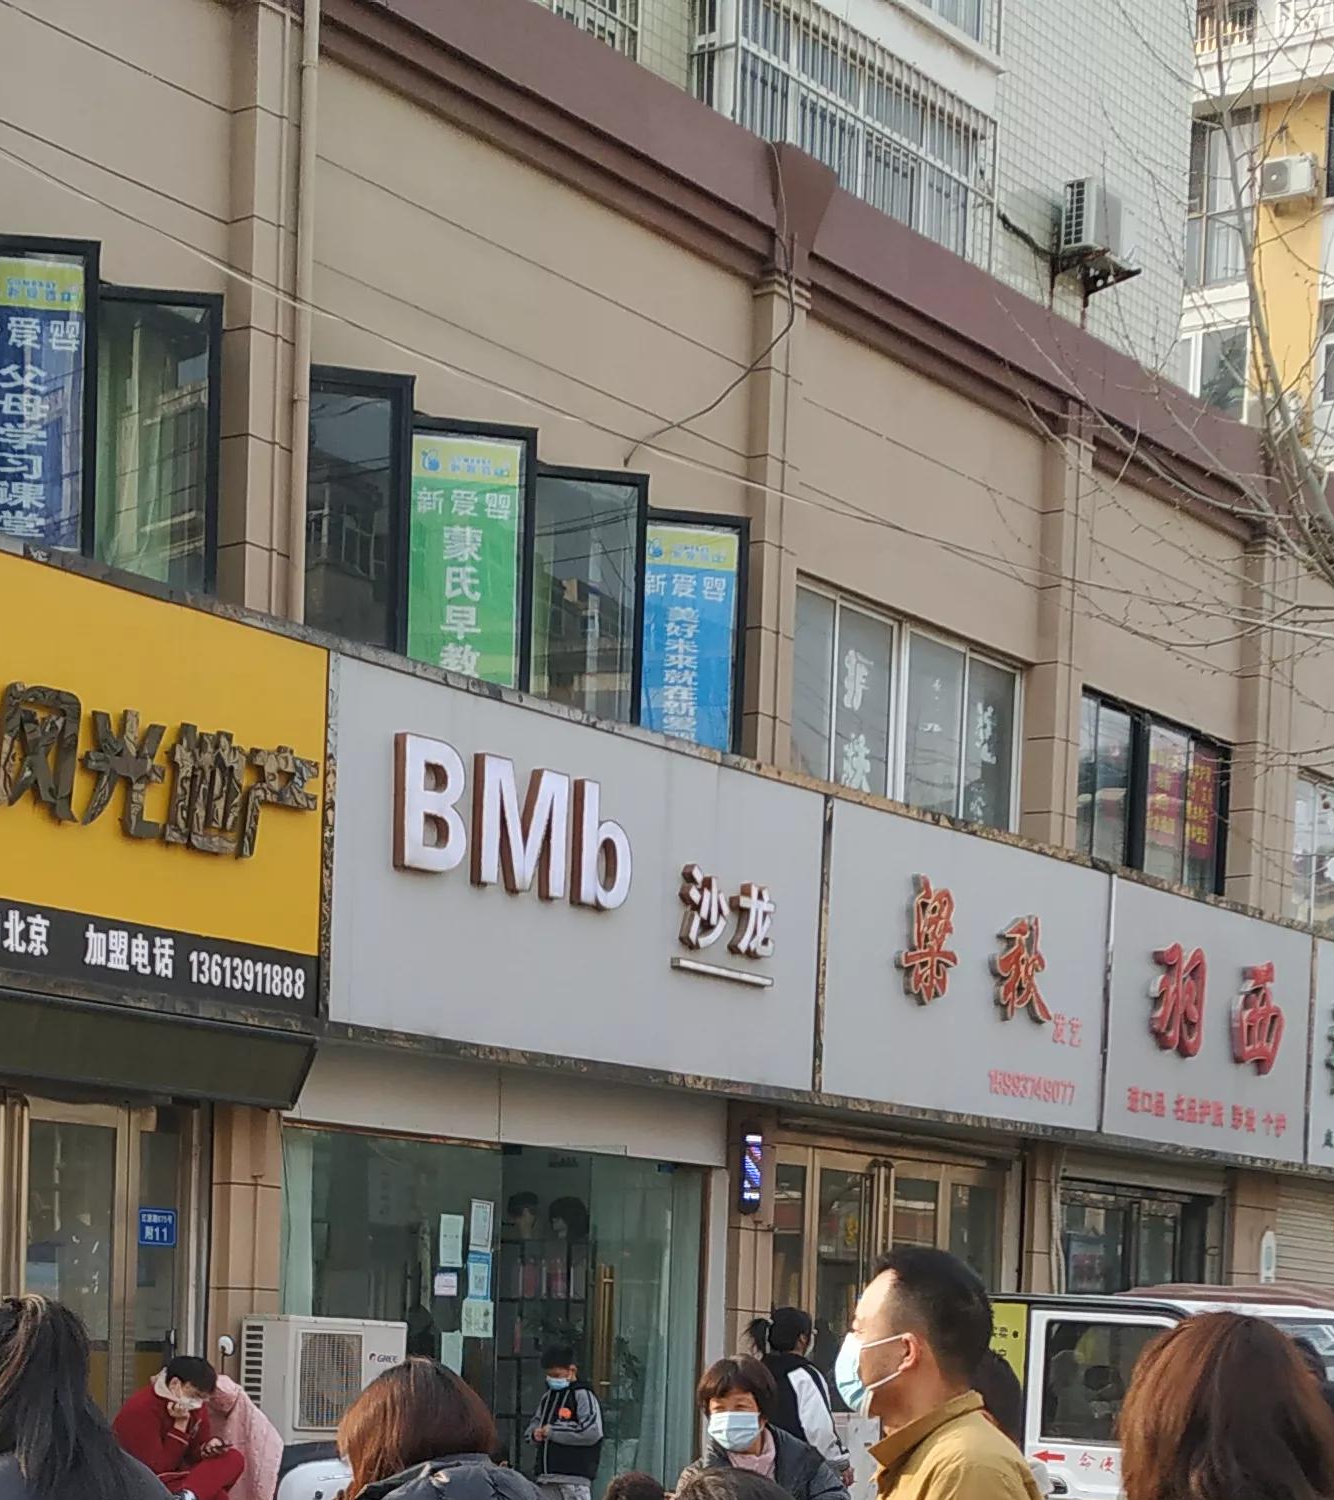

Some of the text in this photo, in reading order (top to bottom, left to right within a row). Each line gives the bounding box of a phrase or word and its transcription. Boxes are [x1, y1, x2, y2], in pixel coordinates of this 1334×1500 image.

[416, 487, 512, 521] 新爱婴
[439, 524, 484, 680] 蒙氏早教
[393, 731, 632, 912] BMb
[678, 864, 776, 960] 沙龙
[84, 923, 175, 979] 加盟电话
[188, 949, 307, 1001] 13613911888
